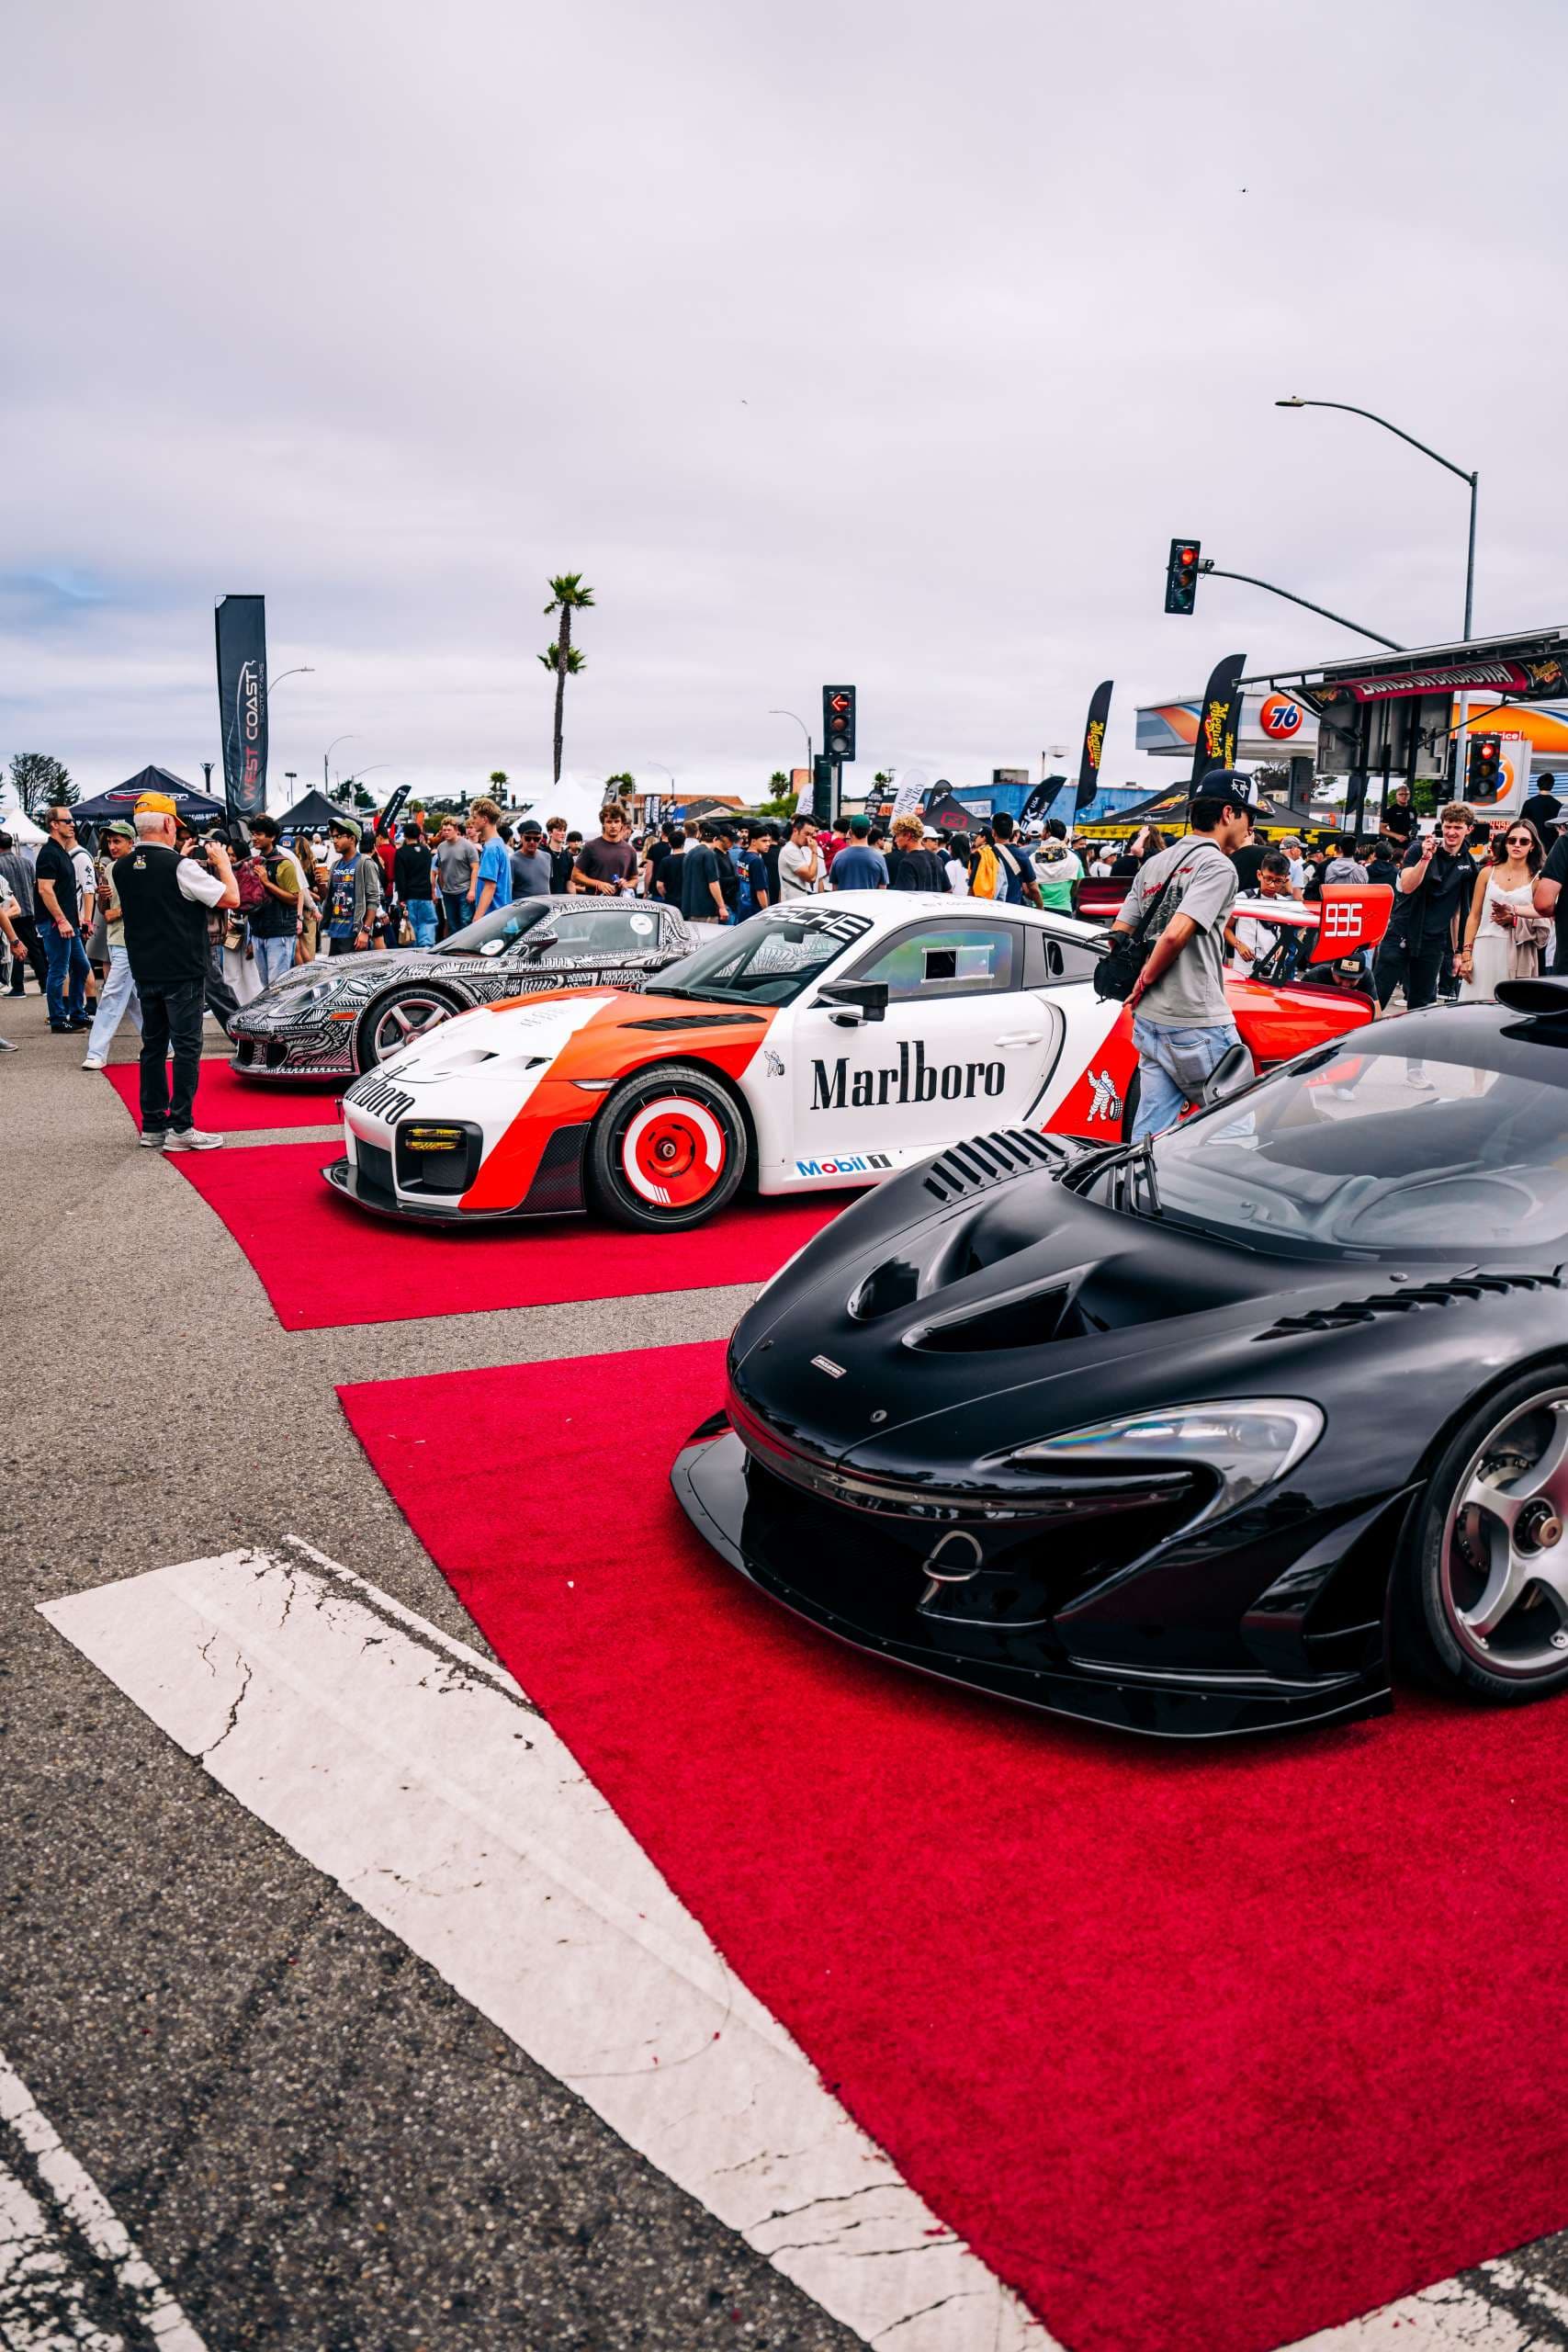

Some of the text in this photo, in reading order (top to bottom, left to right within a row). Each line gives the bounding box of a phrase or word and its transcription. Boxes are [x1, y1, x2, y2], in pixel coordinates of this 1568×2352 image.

[1269, 704, 1299, 729] 76
[243, 669, 258, 802] WEST COAST
[1325, 903, 1363, 938] 935
[809, 1040, 1006, 1110] Marlboro
[795, 1156, 867, 1177] Mobil
